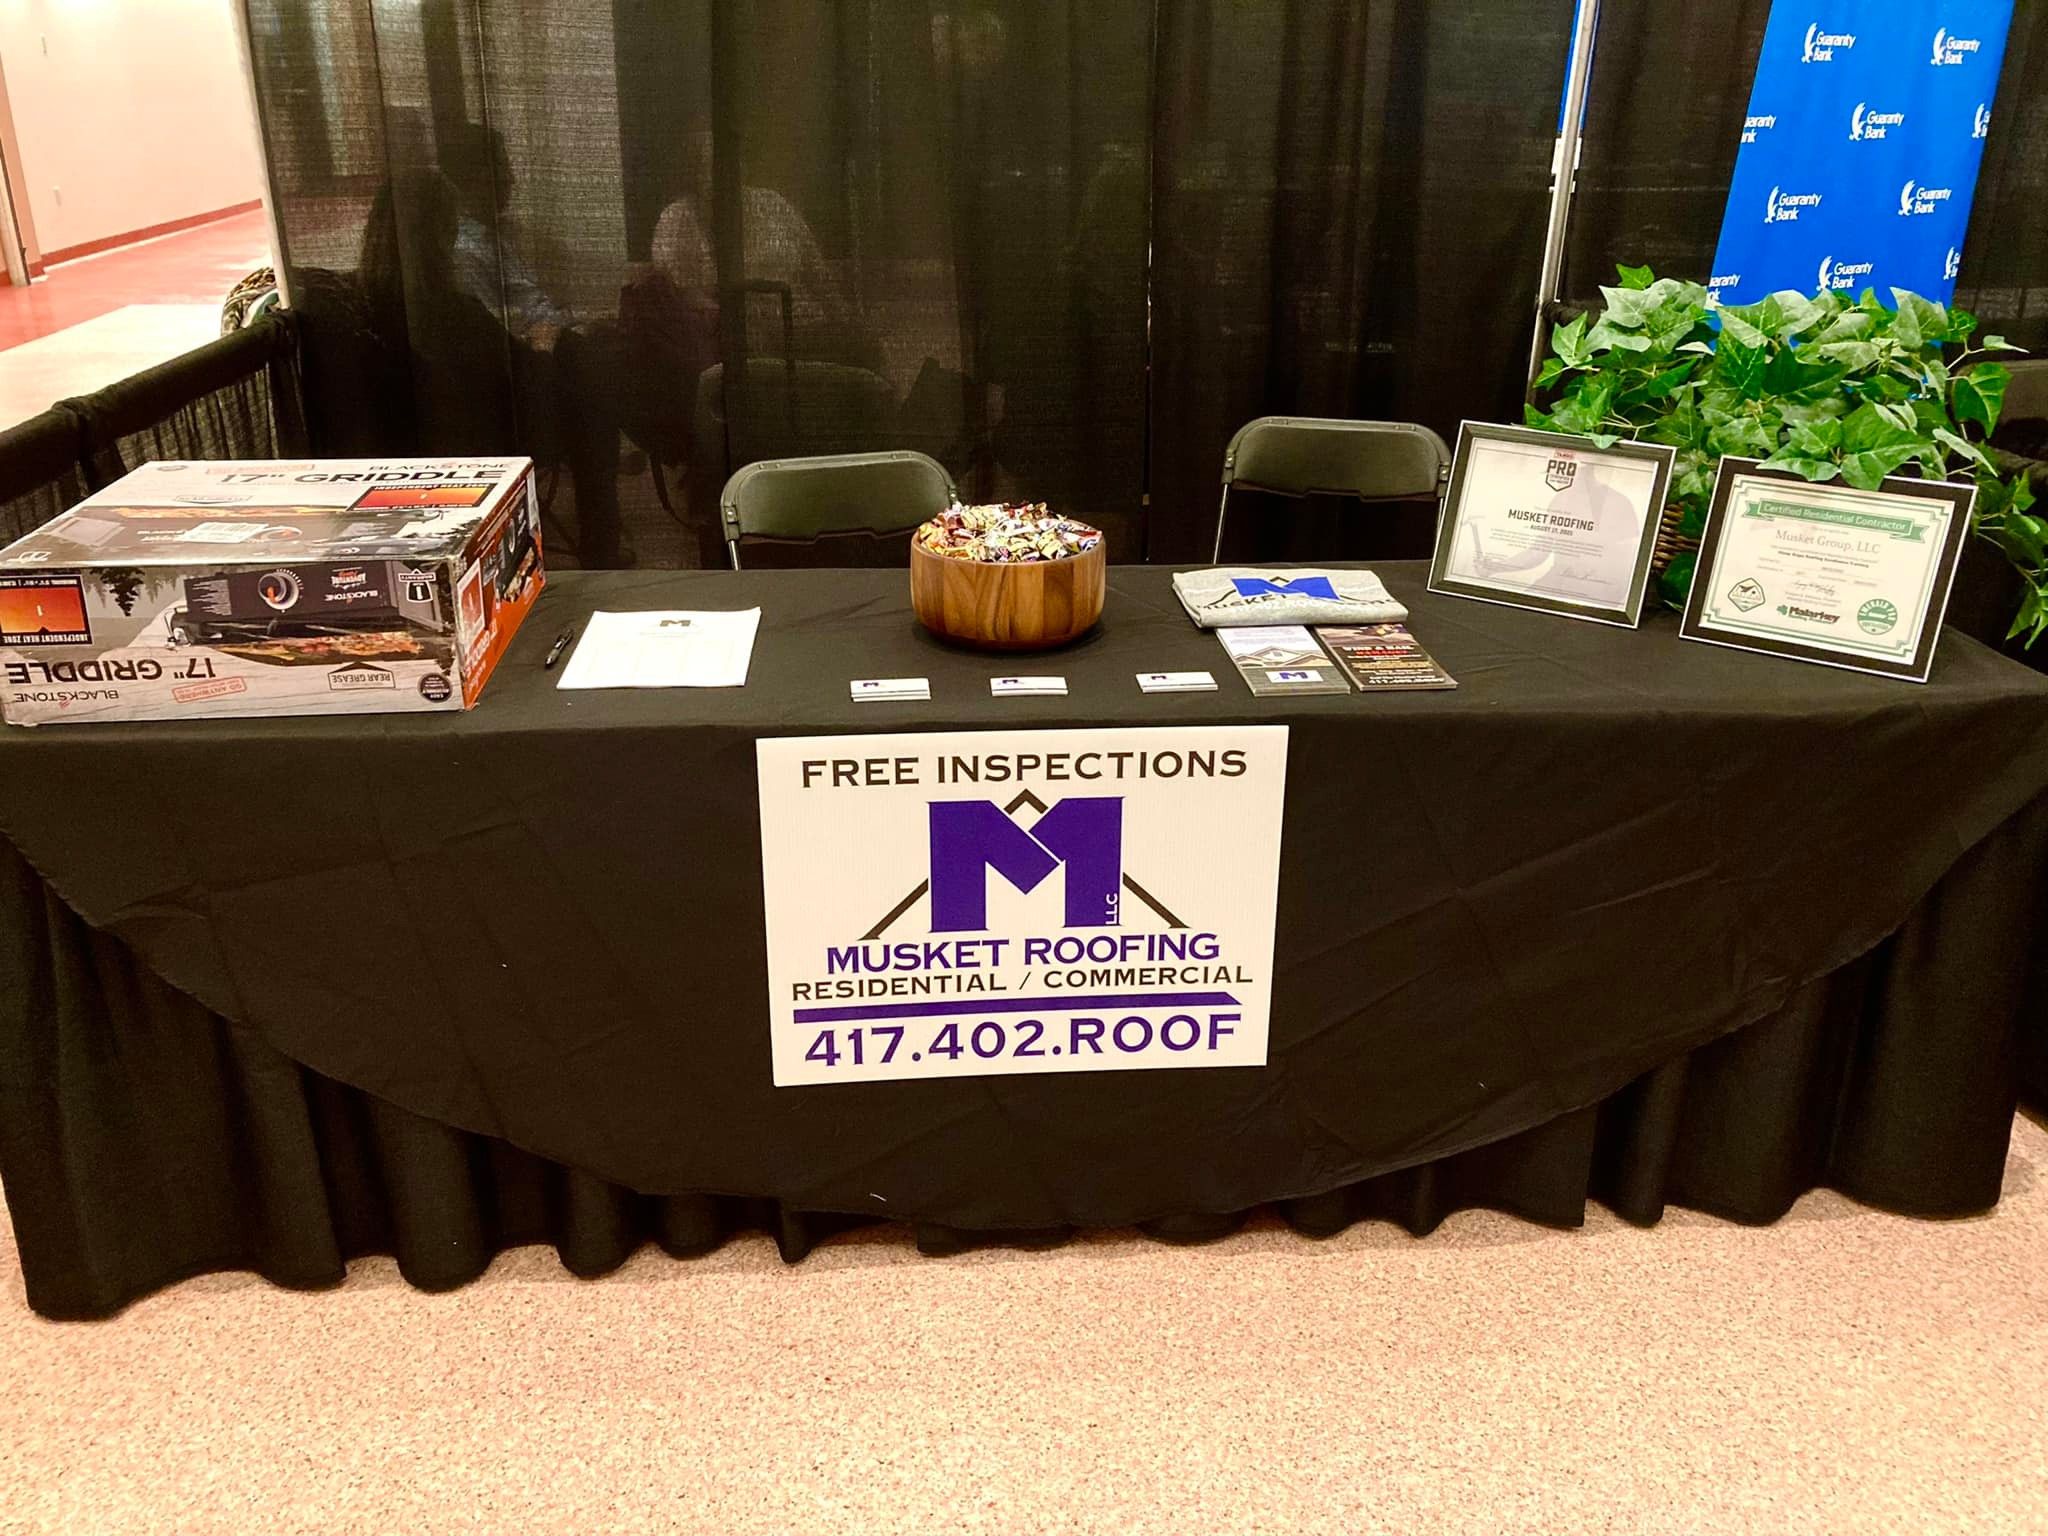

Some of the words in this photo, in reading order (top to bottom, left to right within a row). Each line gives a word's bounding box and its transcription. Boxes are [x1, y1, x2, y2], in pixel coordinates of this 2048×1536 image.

[1816, 31, 1856, 49] Guaranty
[1946, 36, 1981, 53] Guaranty
[1813, 46, 1833, 62] Bank
[1944, 49, 1964, 64] Bank
[1866, 110, 1904, 126] Guaranty
[1864, 124, 1887, 139] Bank
[1778, 192, 1822, 208] Guaranty
[1915, 186, 1952, 202] Guaranty
[1776, 206, 1799, 221] Bank
[1913, 199, 1936, 214] Bank
[1833, 261, 1873, 277] Guaranty
[1831, 274, 1855, 289] Bank
[369, 463, 511, 471] BLACKSTONE
[1546, 459, 1578, 477] PRO
[221, 474, 286, 483] 17"
[294, 470, 507, 483] GRIDDLE
[1508, 508, 1549, 524] MUSKET
[1550, 515, 1594, 531] ROOFING
[1763, 502, 1802, 515] Certified
[1803, 508, 1854, 523] Residential
[1855, 516, 1907, 530] Contractor
[1776, 529, 1815, 544] Musket
[1857, 540, 1881, 554] LLC
[4, 658, 163, 684] GRIDDLE
[174, 657, 217, 679] 17"
[332, 674, 366, 683] GREASE
[367, 673, 391, 682] REAR
[14, 688, 119, 703] BLACKSTONE
[801, 756, 920, 788] FREE
[937, 750, 1249, 784] INSPECTIONS
[1104, 892, 1118, 925] LLC
[826, 938, 1009, 975] MUSKET
[1023, 933, 1221, 966] ROOFING
[791, 972, 1007, 1001] RESIDENTIAL
[1043, 965, 1253, 989] COMMERCIAL
[804, 1012, 1242, 1067] 417.402.ROOF
